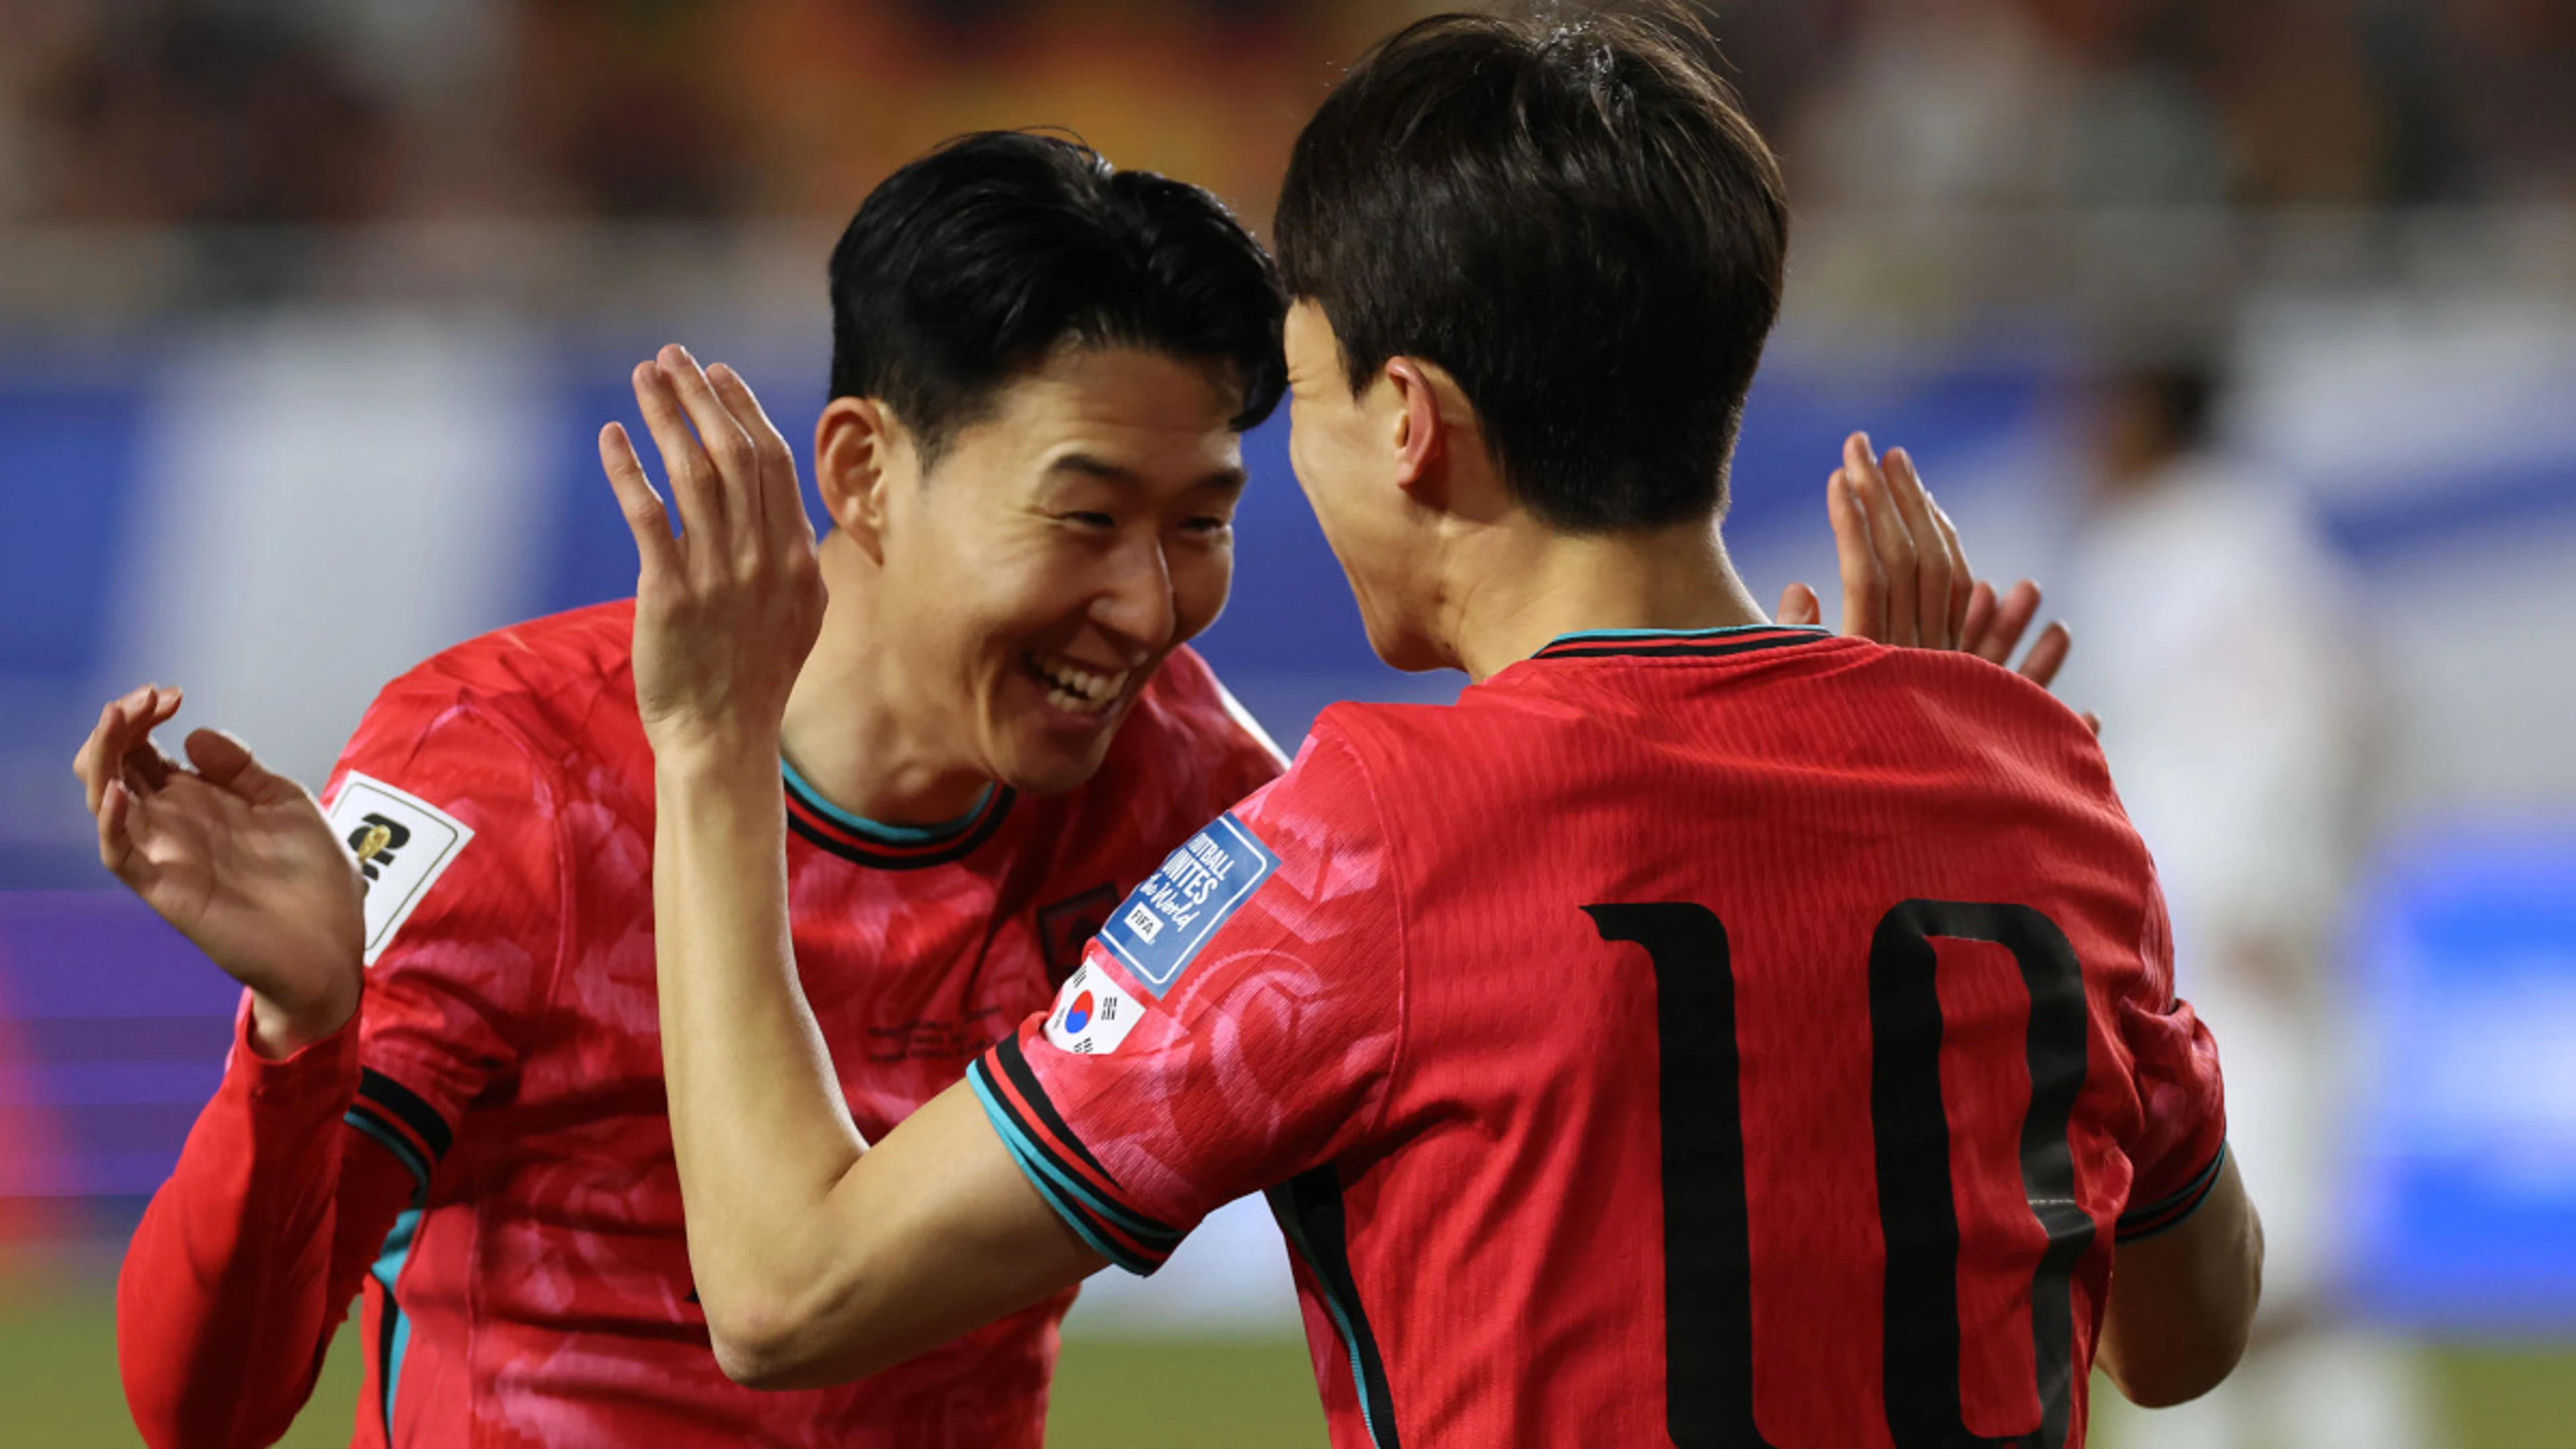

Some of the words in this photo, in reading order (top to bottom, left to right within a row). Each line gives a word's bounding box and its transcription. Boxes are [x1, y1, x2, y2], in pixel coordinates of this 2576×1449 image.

[1130, 910, 1154, 934] FIFA
[1150, 882, 1199, 932] World
[1578, 898, 2096, 1449] 10
